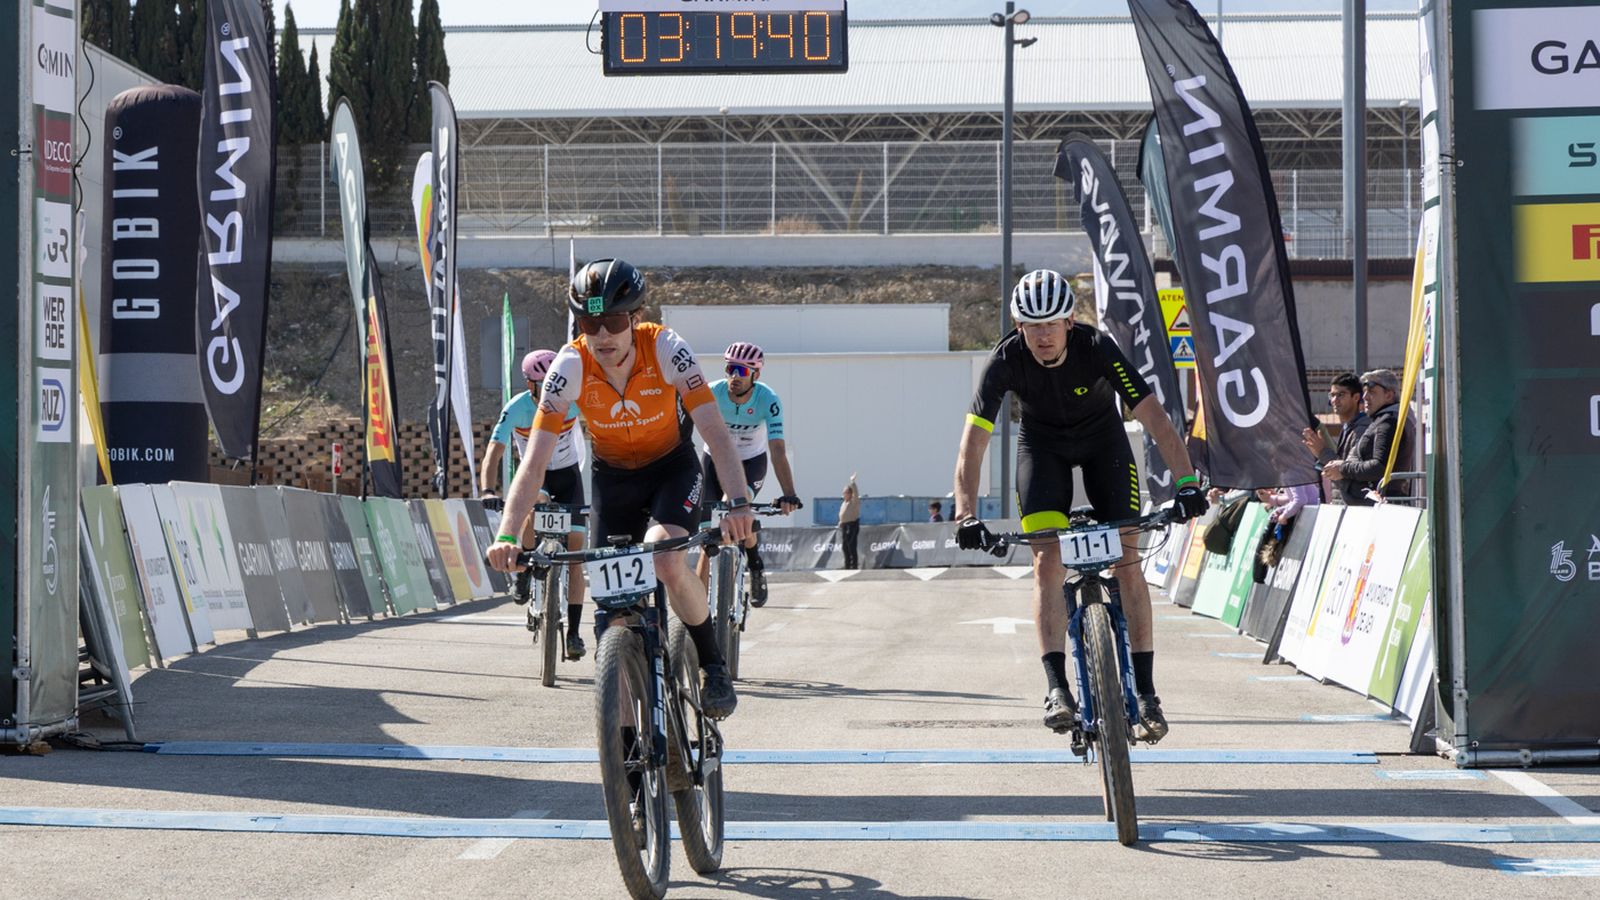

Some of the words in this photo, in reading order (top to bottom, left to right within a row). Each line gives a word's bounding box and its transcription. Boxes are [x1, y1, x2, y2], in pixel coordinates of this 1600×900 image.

[620, 12, 830, 62] 03:19:40
[112, 146, 160, 320] GOBIK
[42, 296, 65, 322] WER
[45, 324, 65, 349] ADE
[671, 348, 690, 366] an
[677, 356, 696, 373] ex
[548, 371, 568, 387] an
[544, 381, 564, 397] ex
[636, 411, 665, 425] Sport
[541, 513, 565, 530] 10-1
[757, 543, 793, 552] ARMIN
[813, 543, 843, 552] GARM
[1070, 532, 1110, 558] 11-1
[296, 540, 328, 571] GARMIN
[600, 557, 646, 591] 11-2
